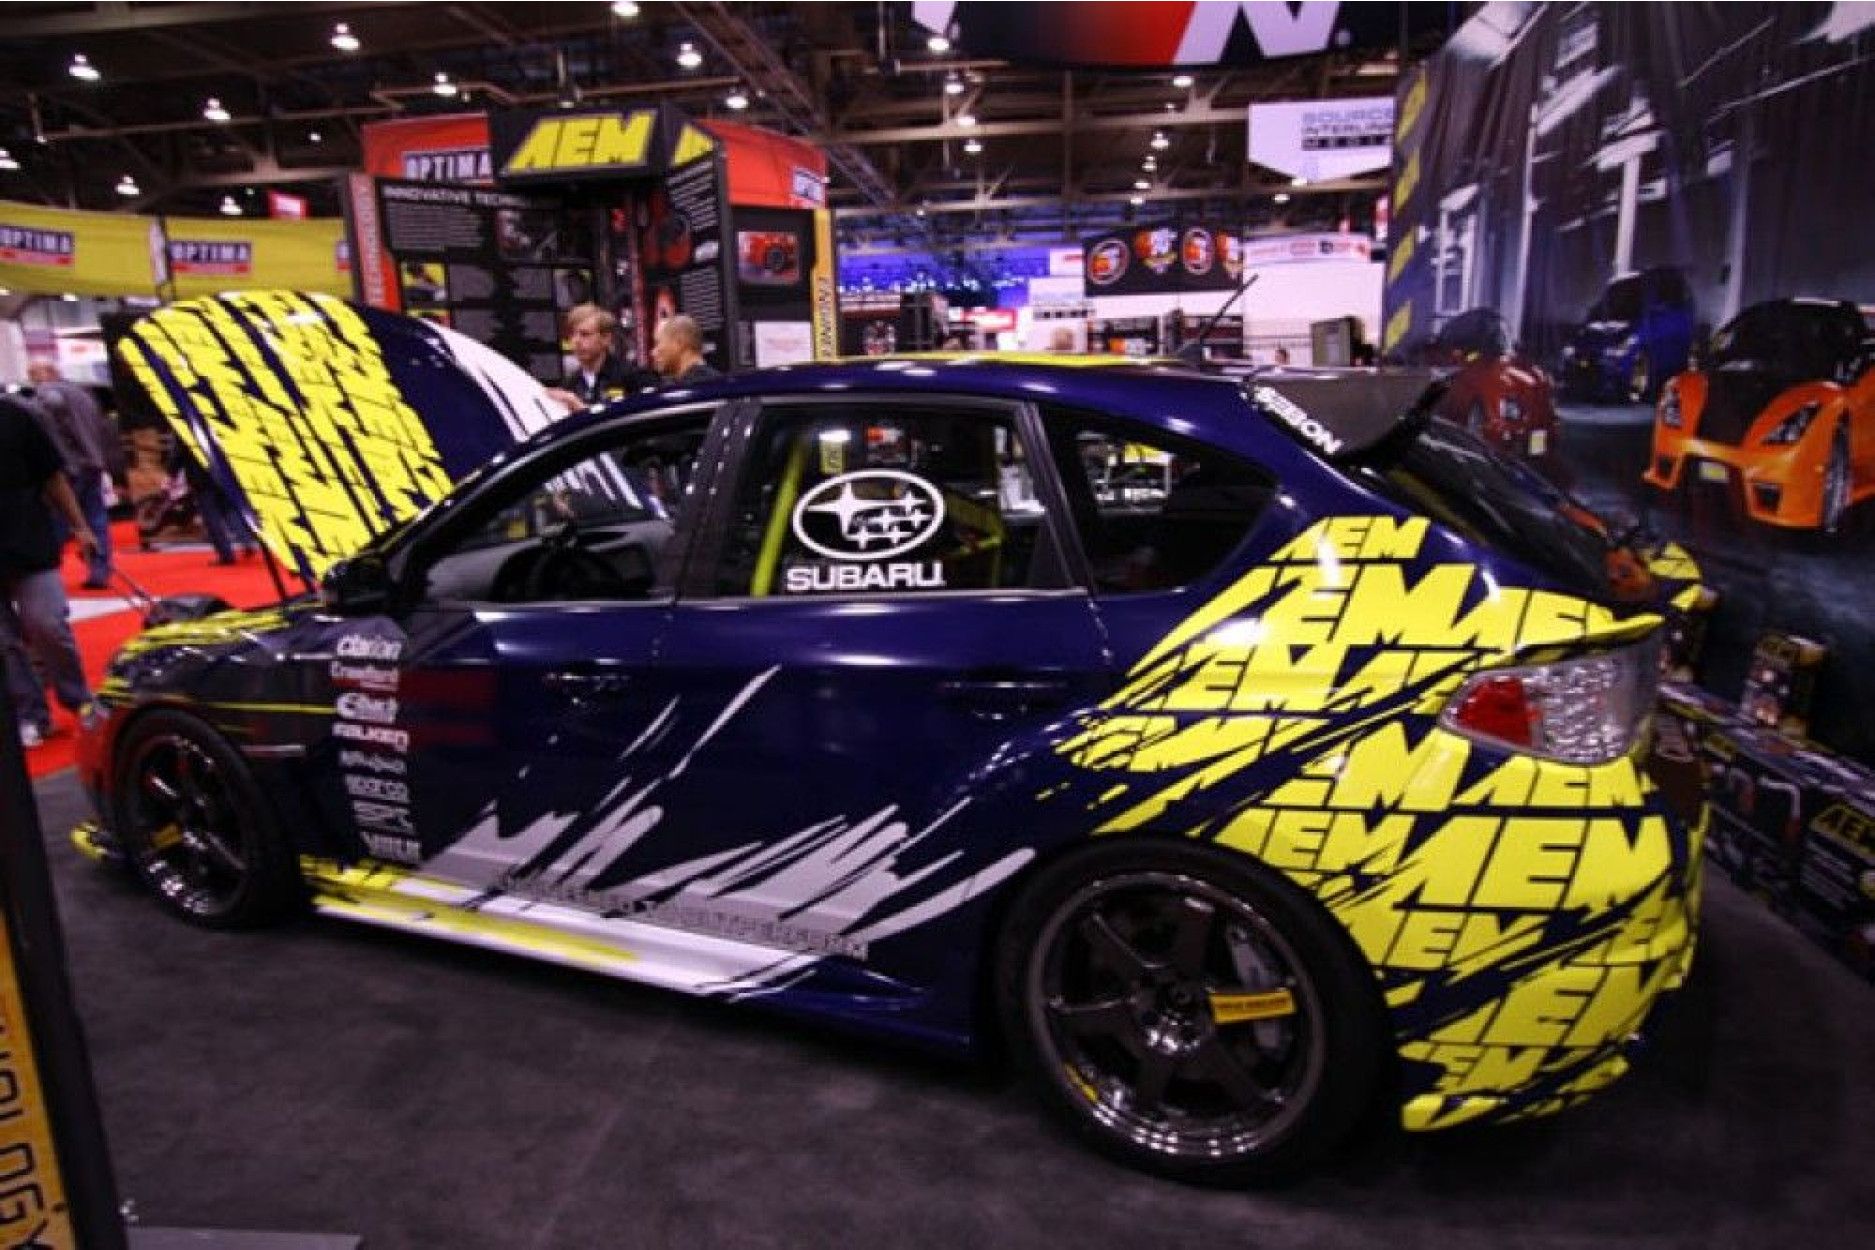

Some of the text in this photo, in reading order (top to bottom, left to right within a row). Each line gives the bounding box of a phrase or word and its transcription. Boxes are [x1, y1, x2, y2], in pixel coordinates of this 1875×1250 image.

[404, 152, 493, 180] OPTIMA
[507, 111, 656, 173] AEM
[1268, 516, 1430, 561] AEM
[786, 561, 945, 591] SUBARU
[1452, 755, 1648, 806] AEM
[1212, 808, 1416, 876] AEM
[1372, 815, 1674, 914] AEM
